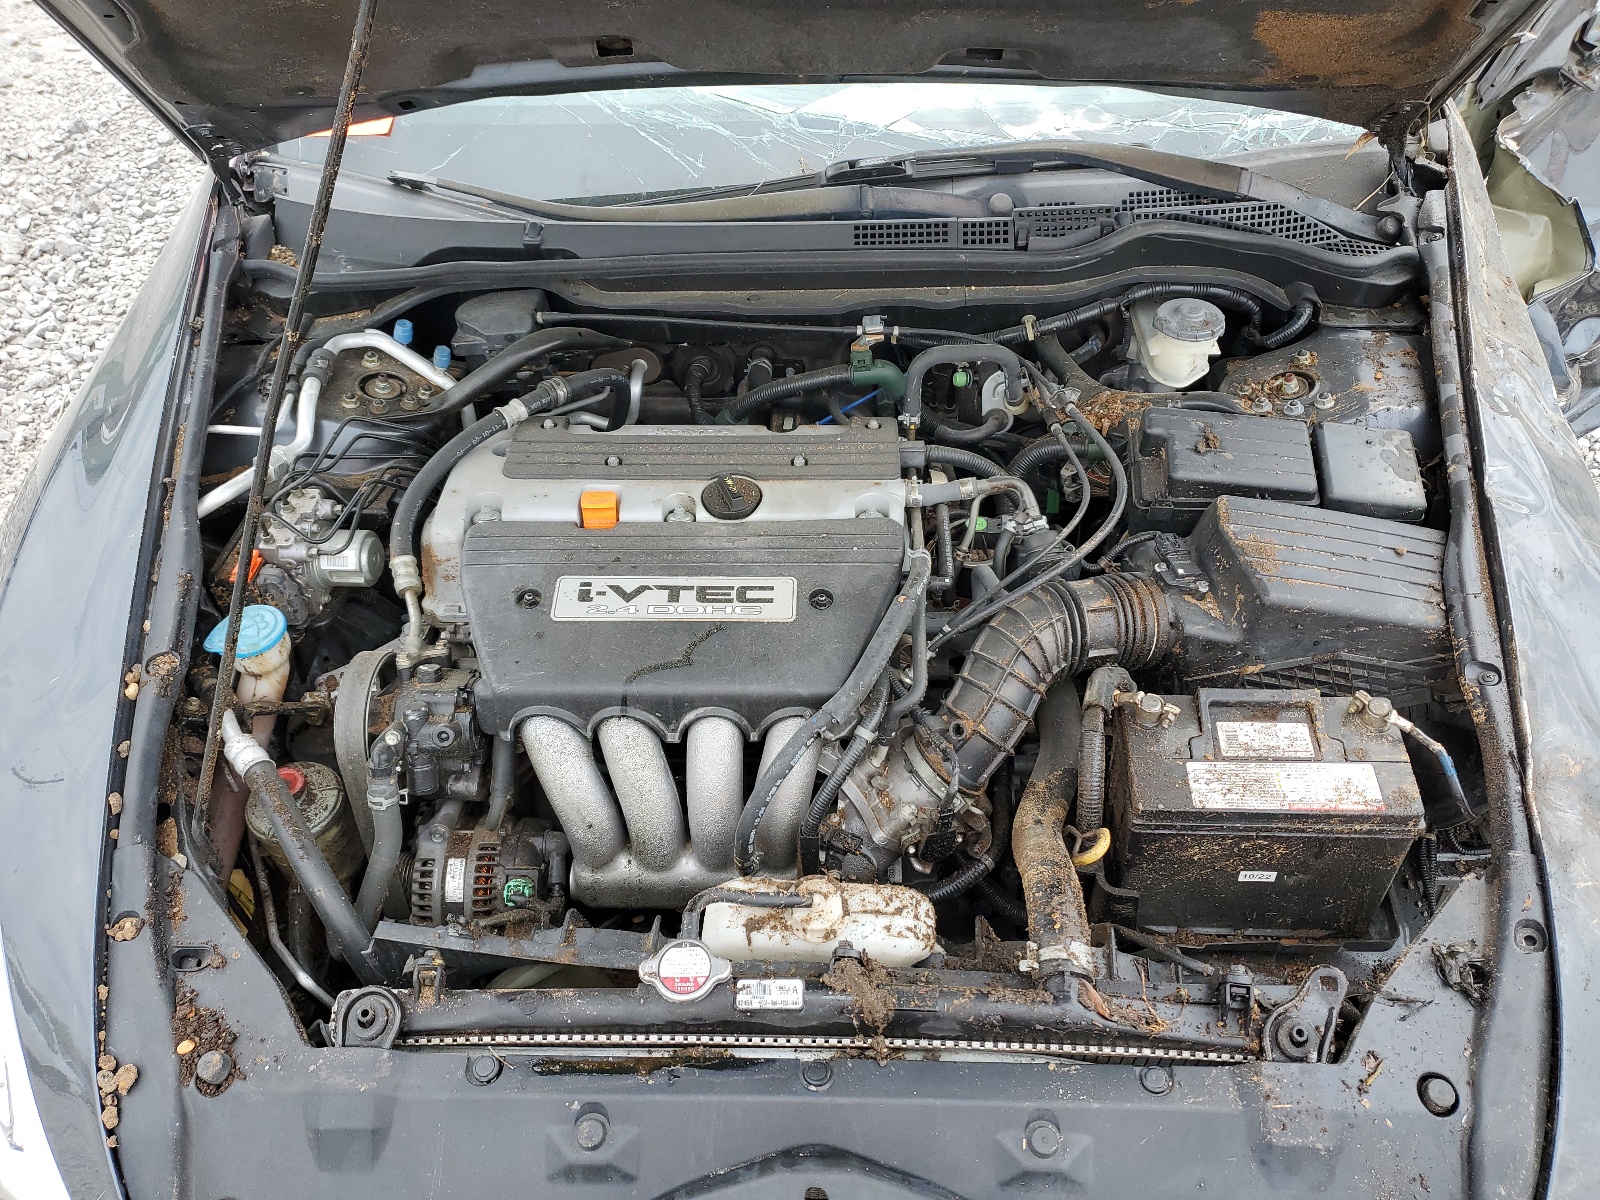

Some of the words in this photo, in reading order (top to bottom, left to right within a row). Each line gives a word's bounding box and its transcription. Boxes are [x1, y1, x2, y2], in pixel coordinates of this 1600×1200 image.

[577, 581, 775, 604] i-VTEC
[586, 604, 640, 615] 2.4
[646, 604, 763, 616] DOHC
